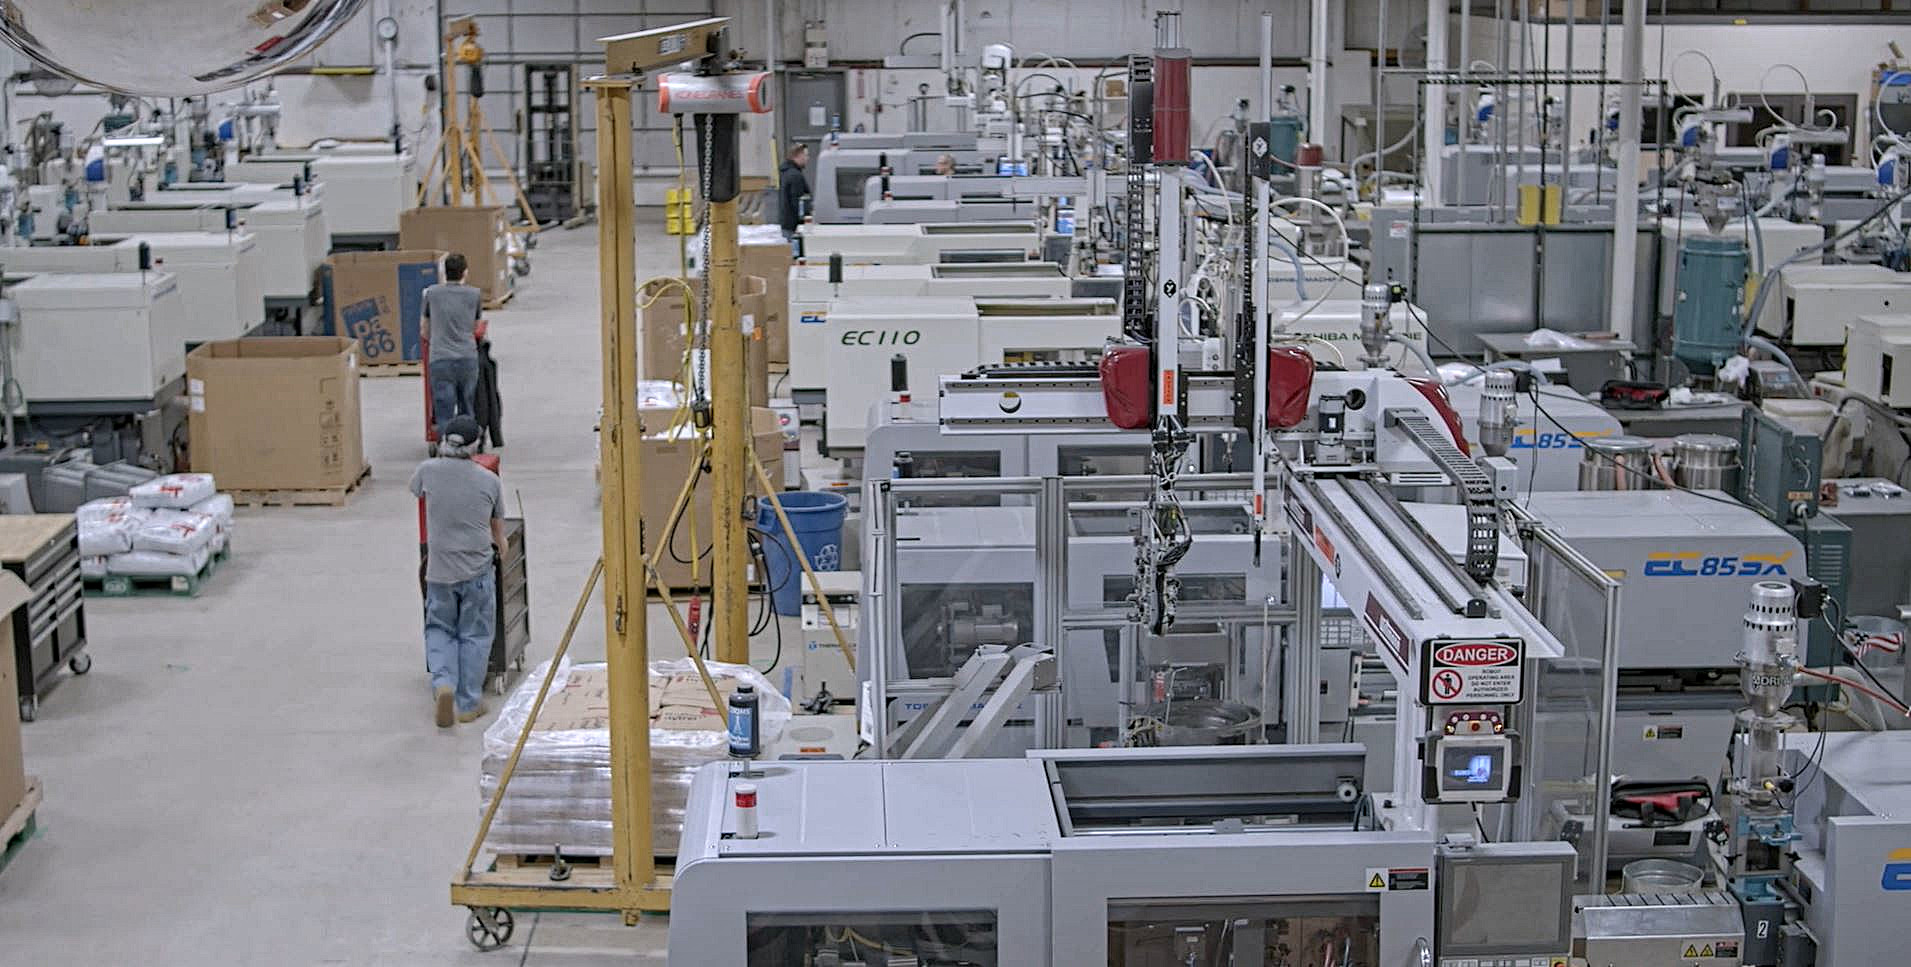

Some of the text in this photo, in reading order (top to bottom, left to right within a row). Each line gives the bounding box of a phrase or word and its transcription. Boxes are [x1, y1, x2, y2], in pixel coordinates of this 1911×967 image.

[841, 330, 920, 346] EC110
[1443, 647, 1509, 661] DANGER
[1758, 922, 1767, 937] 2
